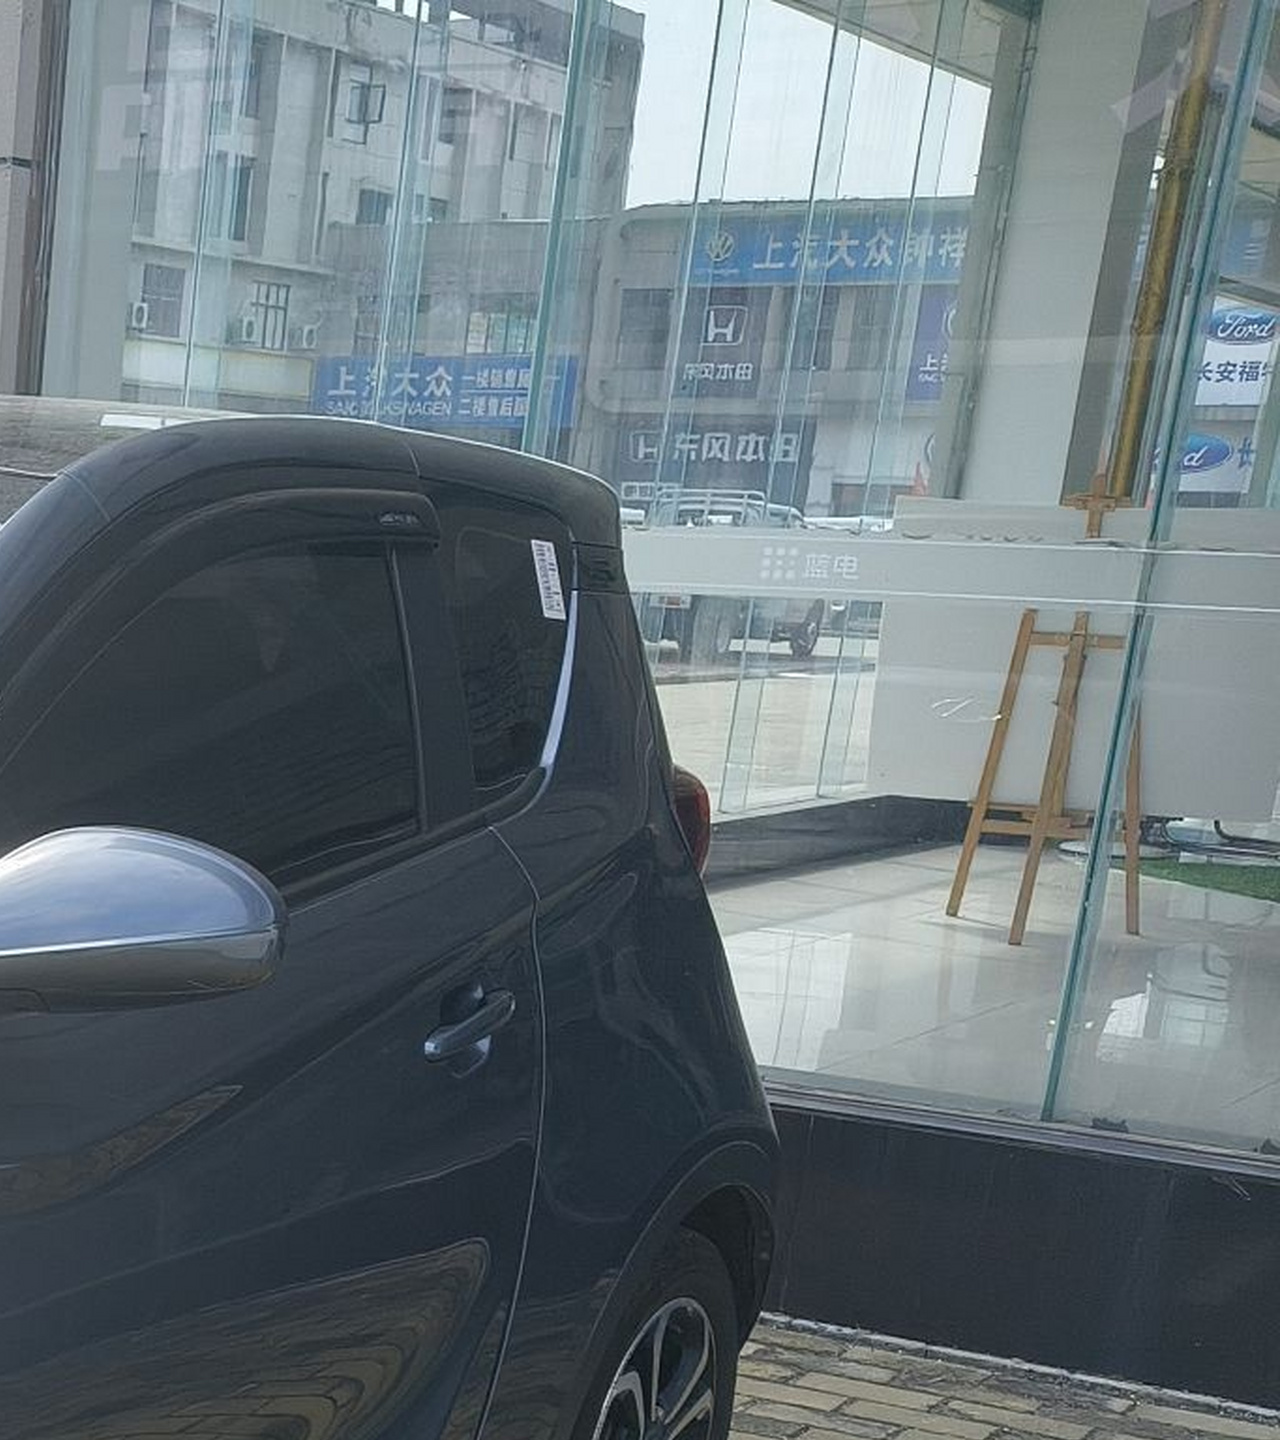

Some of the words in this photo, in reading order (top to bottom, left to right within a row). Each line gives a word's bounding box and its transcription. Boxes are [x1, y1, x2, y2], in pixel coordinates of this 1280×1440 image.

[1217, 312, 1276, 338] Ford
[673, 431, 800, 463] 东风本田
[803, 553, 860, 580] 蓝电
